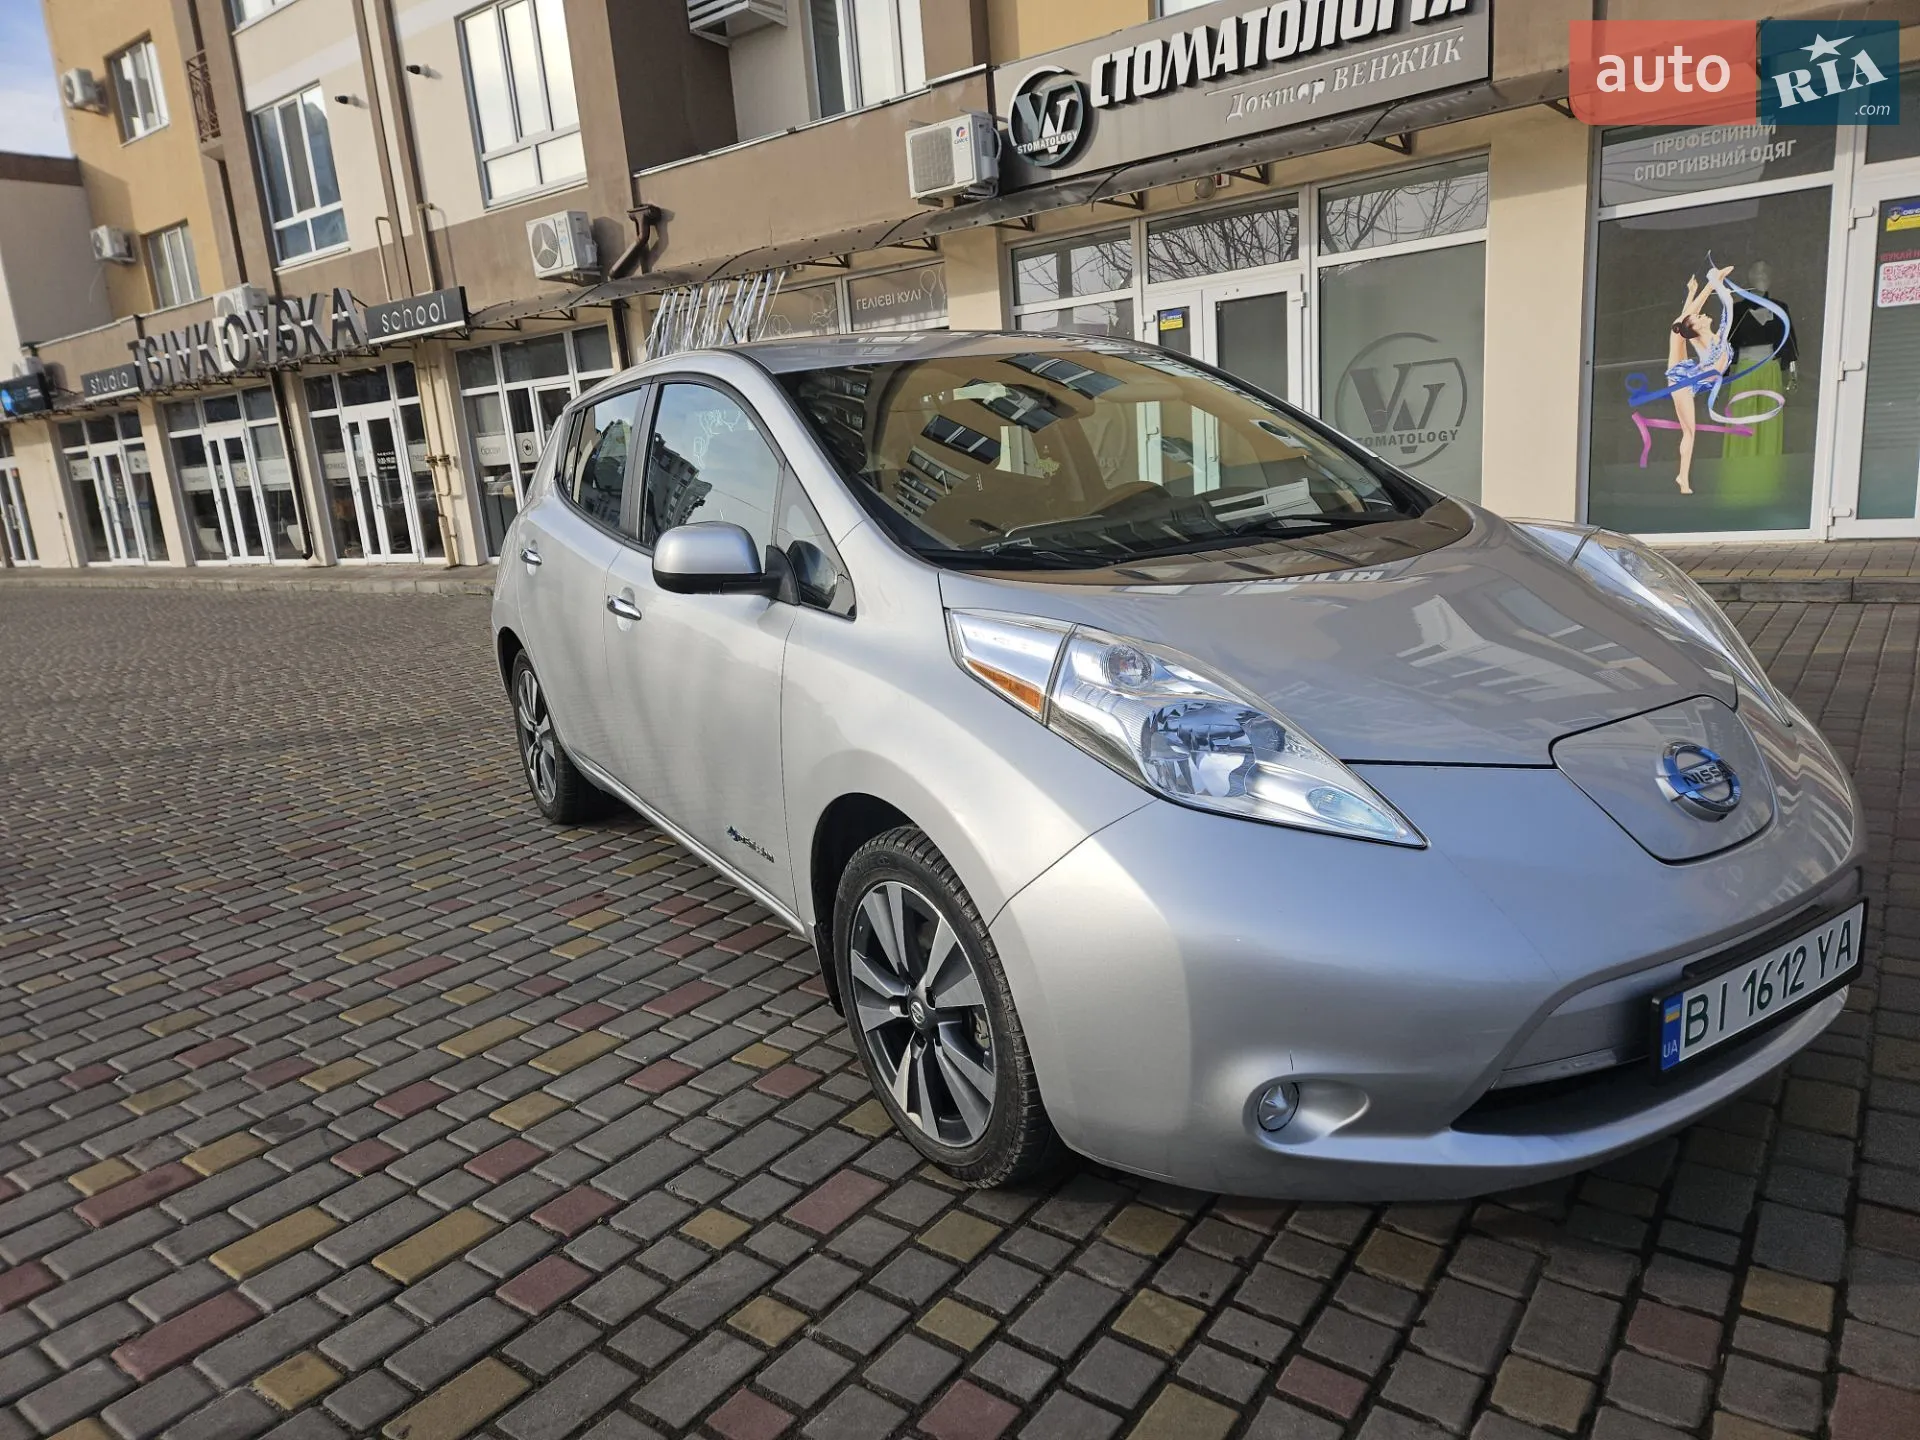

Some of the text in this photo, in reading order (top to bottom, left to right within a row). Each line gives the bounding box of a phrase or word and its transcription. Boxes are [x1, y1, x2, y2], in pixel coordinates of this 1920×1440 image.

[1226, 36, 1465, 123] Доктор ВЕНЖИК
[1017, 129, 1078, 154] STOMATOLOGY
[1634, 139, 1797, 182] СПОРТИВНИЙ ОДЯГ
[856, 288, 922, 311] ГЕЛІЄВІ КУЛІ
[90, 370, 129, 395] studio
[381, 294, 447, 333] school
[1352, 429, 1459, 447] TOMATOLOGY
[1683, 761, 1733, 787] NISS
[1684, 919, 1851, 1048] BI 1612 YA
[1663, 1041, 1679, 1058] UA
